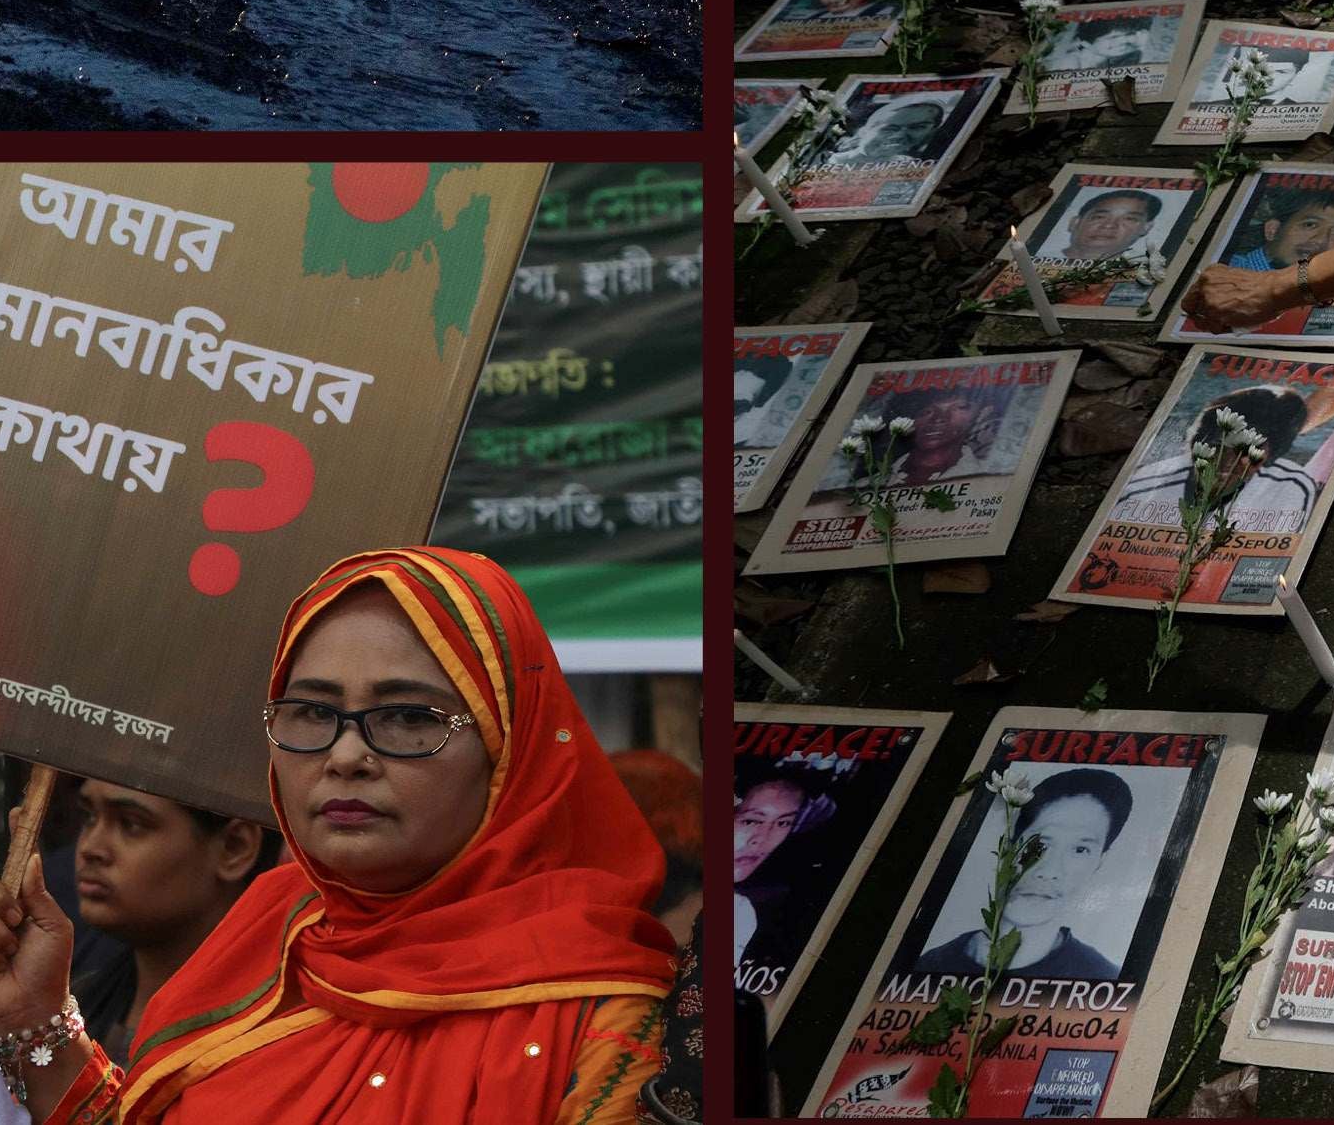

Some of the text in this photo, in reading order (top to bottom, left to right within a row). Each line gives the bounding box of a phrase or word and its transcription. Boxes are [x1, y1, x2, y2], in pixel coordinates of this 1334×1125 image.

[1048, 70, 1102, 81] NICASIO
[1103, 66, 1150, 76] ROXAS
[1196, 105, 1322, 114] HERMN LAGMAN
[1078, 175, 1207, 191] SURFACE!
[19, 172, 235, 274] আমার
[1028, 258, 1094, 269] OPOLDO
[868, 359, 1059, 396] SURFACE!
[743, 454, 766, 468] Sr.
[848, 485, 922, 507] JOSEPH
[980, 496, 1003, 507] 1988
[188, 420, 316, 597] ?
[970, 507, 998, 519] Pasay
[804, 517, 855, 532] STOP
[1234, 507, 1307, 533] ESPIRITU
[794, 530, 854, 543] ENFORCED
[1098, 541, 1114, 552] IN
[112, 709, 175, 745] স্বজন
[734, 722, 904, 761] URFACE!
[1004, 731, 1206, 768] SURFACE!
[734, 960, 786, 996] ÑOS
[1279, 961, 1317, 996] STOP
[1000, 978, 1137, 1013] DETROZ
[847, 1039, 868, 1054] IN
[1068, 1056, 1090, 1069] STOP
[1051, 1067, 1095, 1082] ENFORCED
